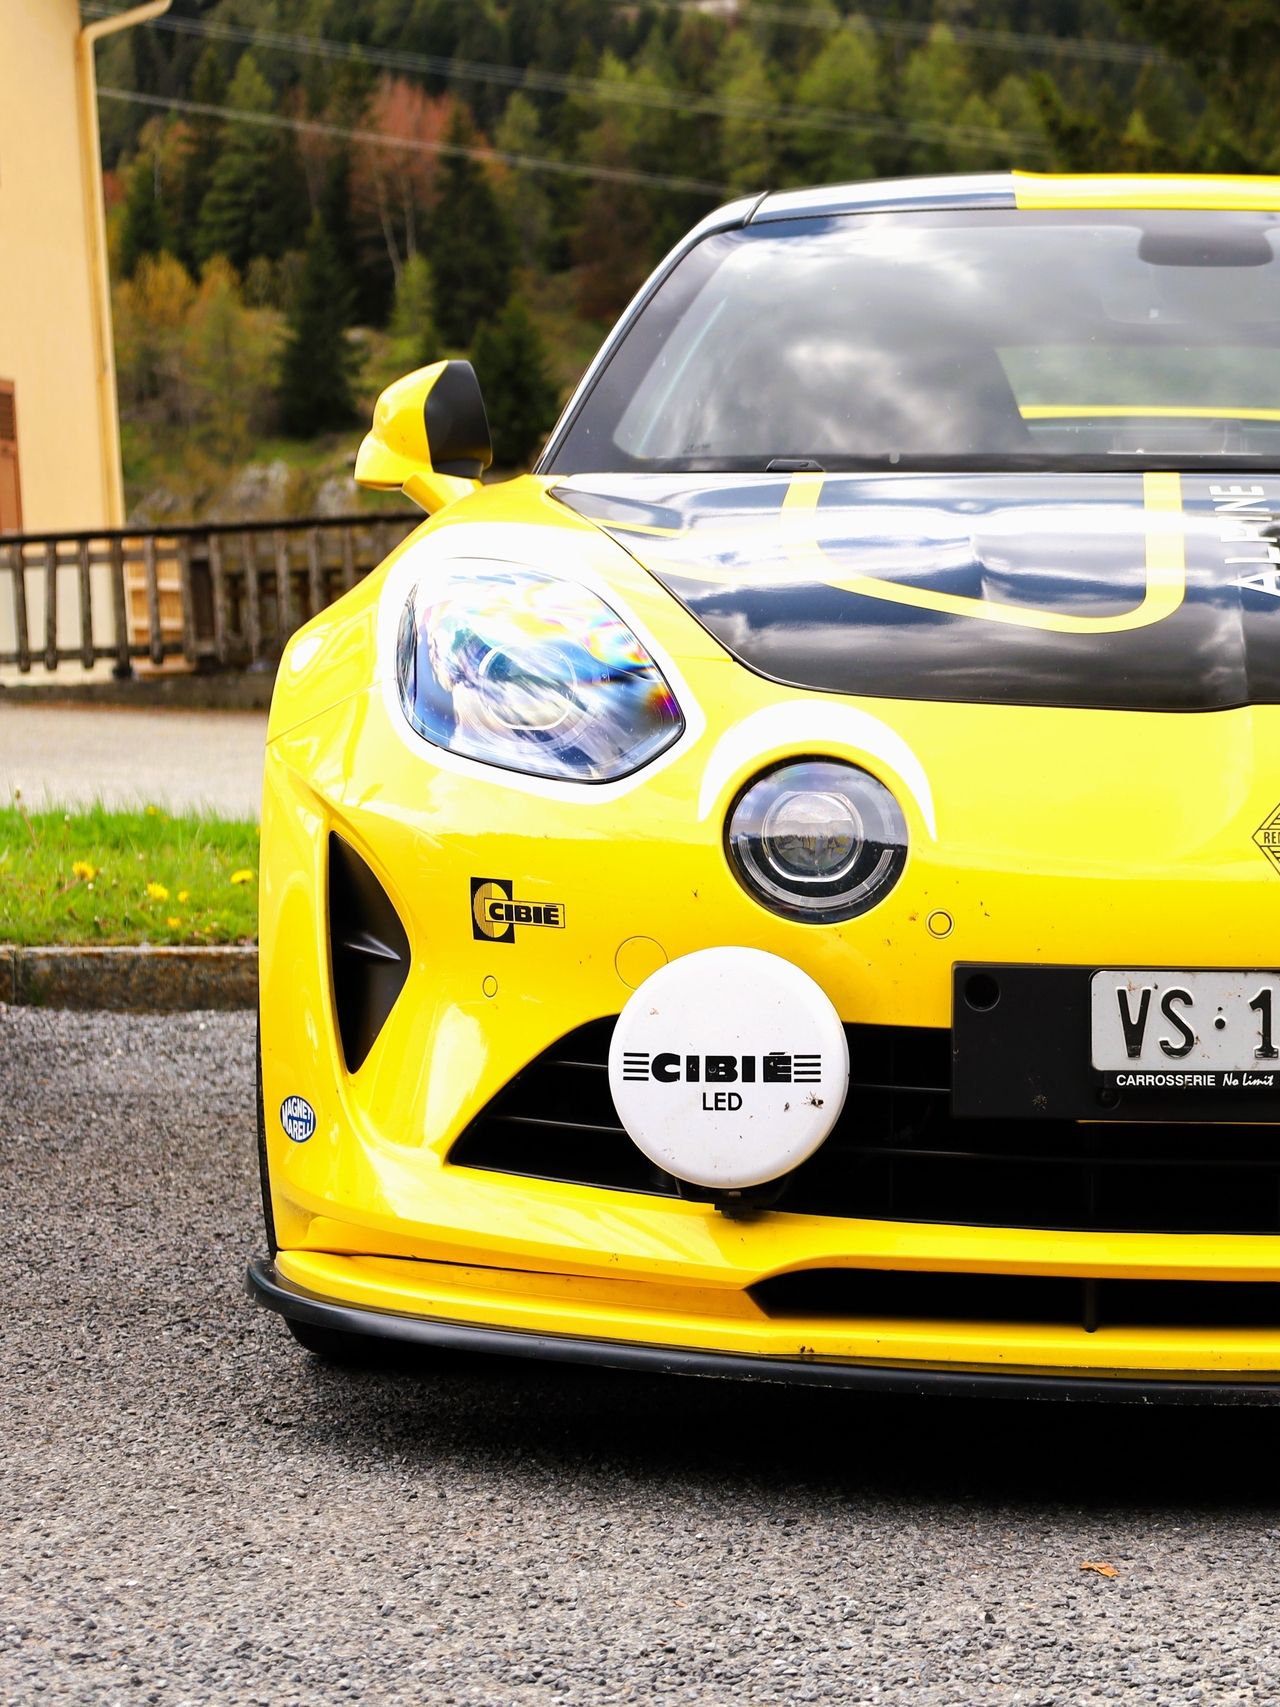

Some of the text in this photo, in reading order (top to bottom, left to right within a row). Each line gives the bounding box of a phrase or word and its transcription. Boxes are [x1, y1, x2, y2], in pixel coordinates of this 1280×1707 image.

[489, 902, 560, 925] CIBIÉ
[1116, 988, 1196, 1058] VS
[651, 1051, 792, 1083] CIBIÉ
[1116, 1074, 1216, 1087] CARROSSERIE
[1222, 1072, 1240, 1087] No
[1242, 1072, 1274, 1087] Limit
[702, 1092, 743, 1111] LED
